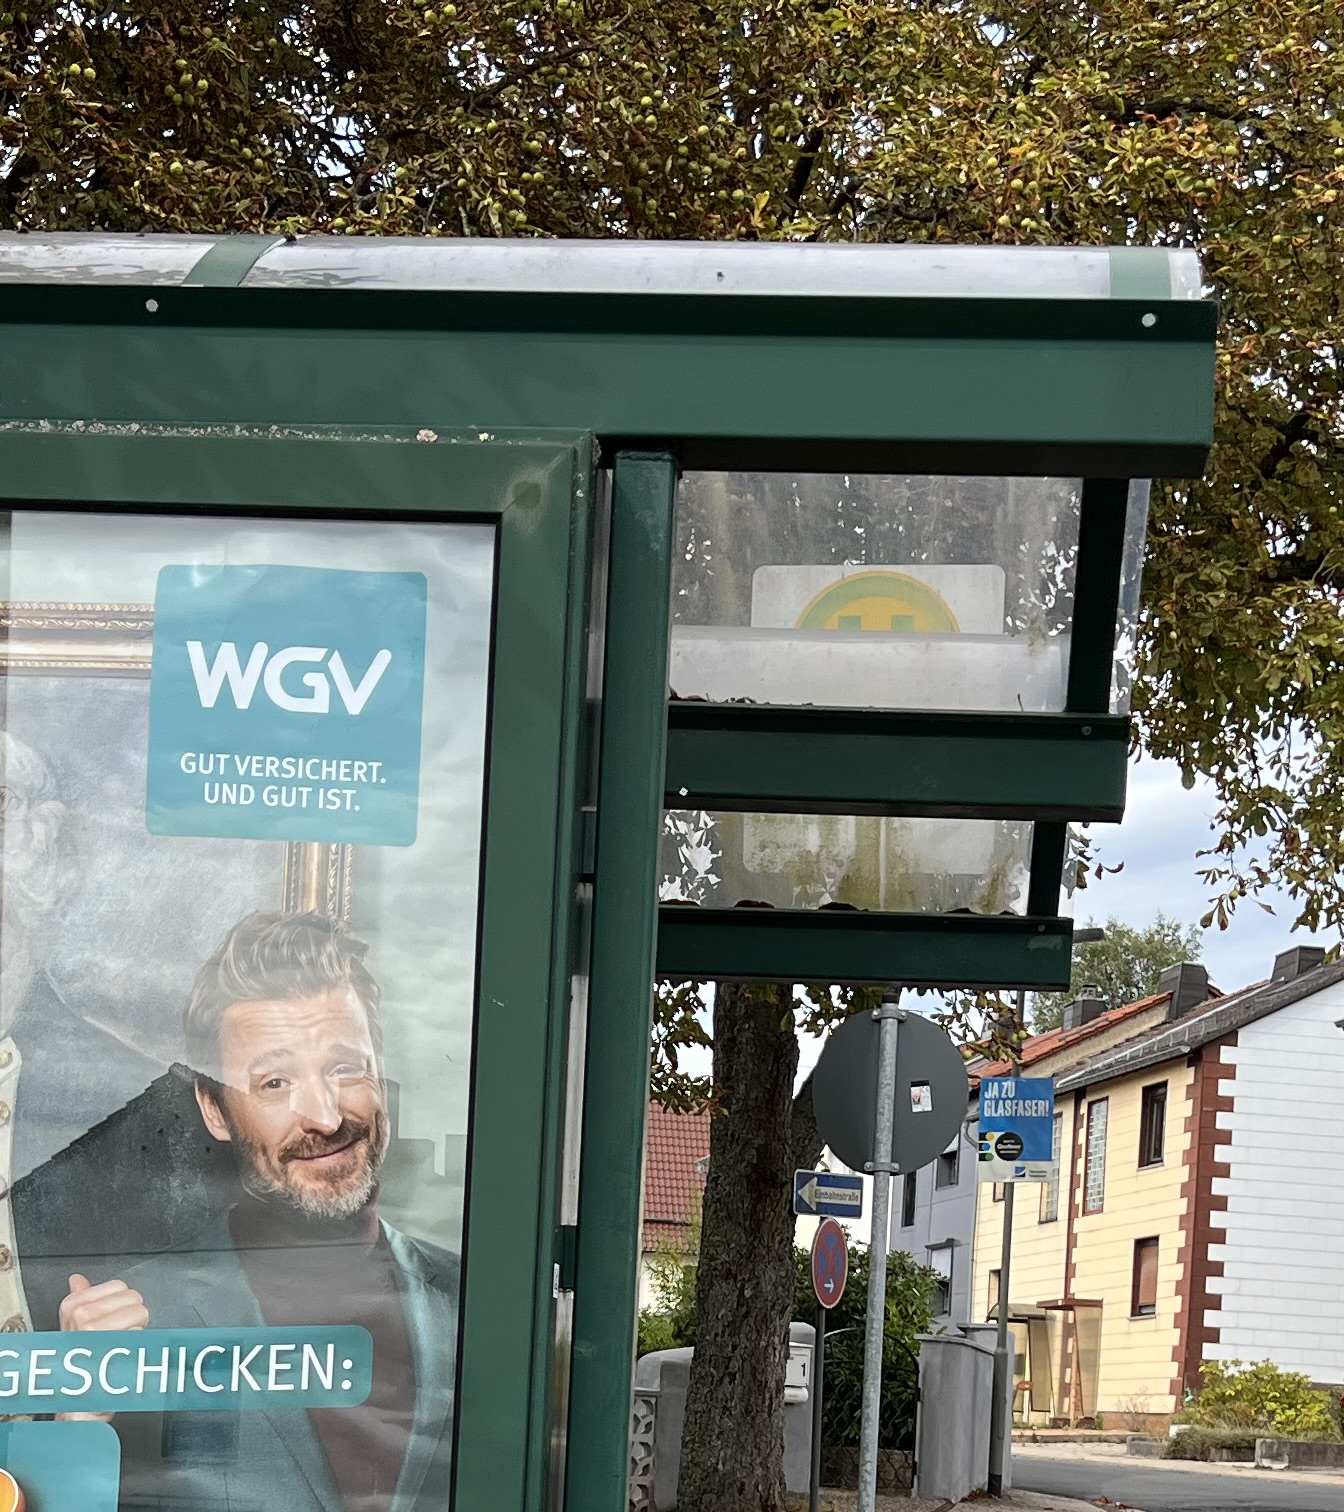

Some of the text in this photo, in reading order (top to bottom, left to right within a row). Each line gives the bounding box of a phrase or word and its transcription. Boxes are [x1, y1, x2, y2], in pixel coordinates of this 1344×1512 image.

[186, 640, 392, 715] WGV
[180, 752, 387, 784] GUT VERSICHERT.
[204, 782, 361, 811] UND GUT IST.
[984, 1081, 1016, 1099] JA ZU
[983, 1100, 1050, 1117] GLASFASER!
[814, 1188, 859, 1202] Einbahnstraße
